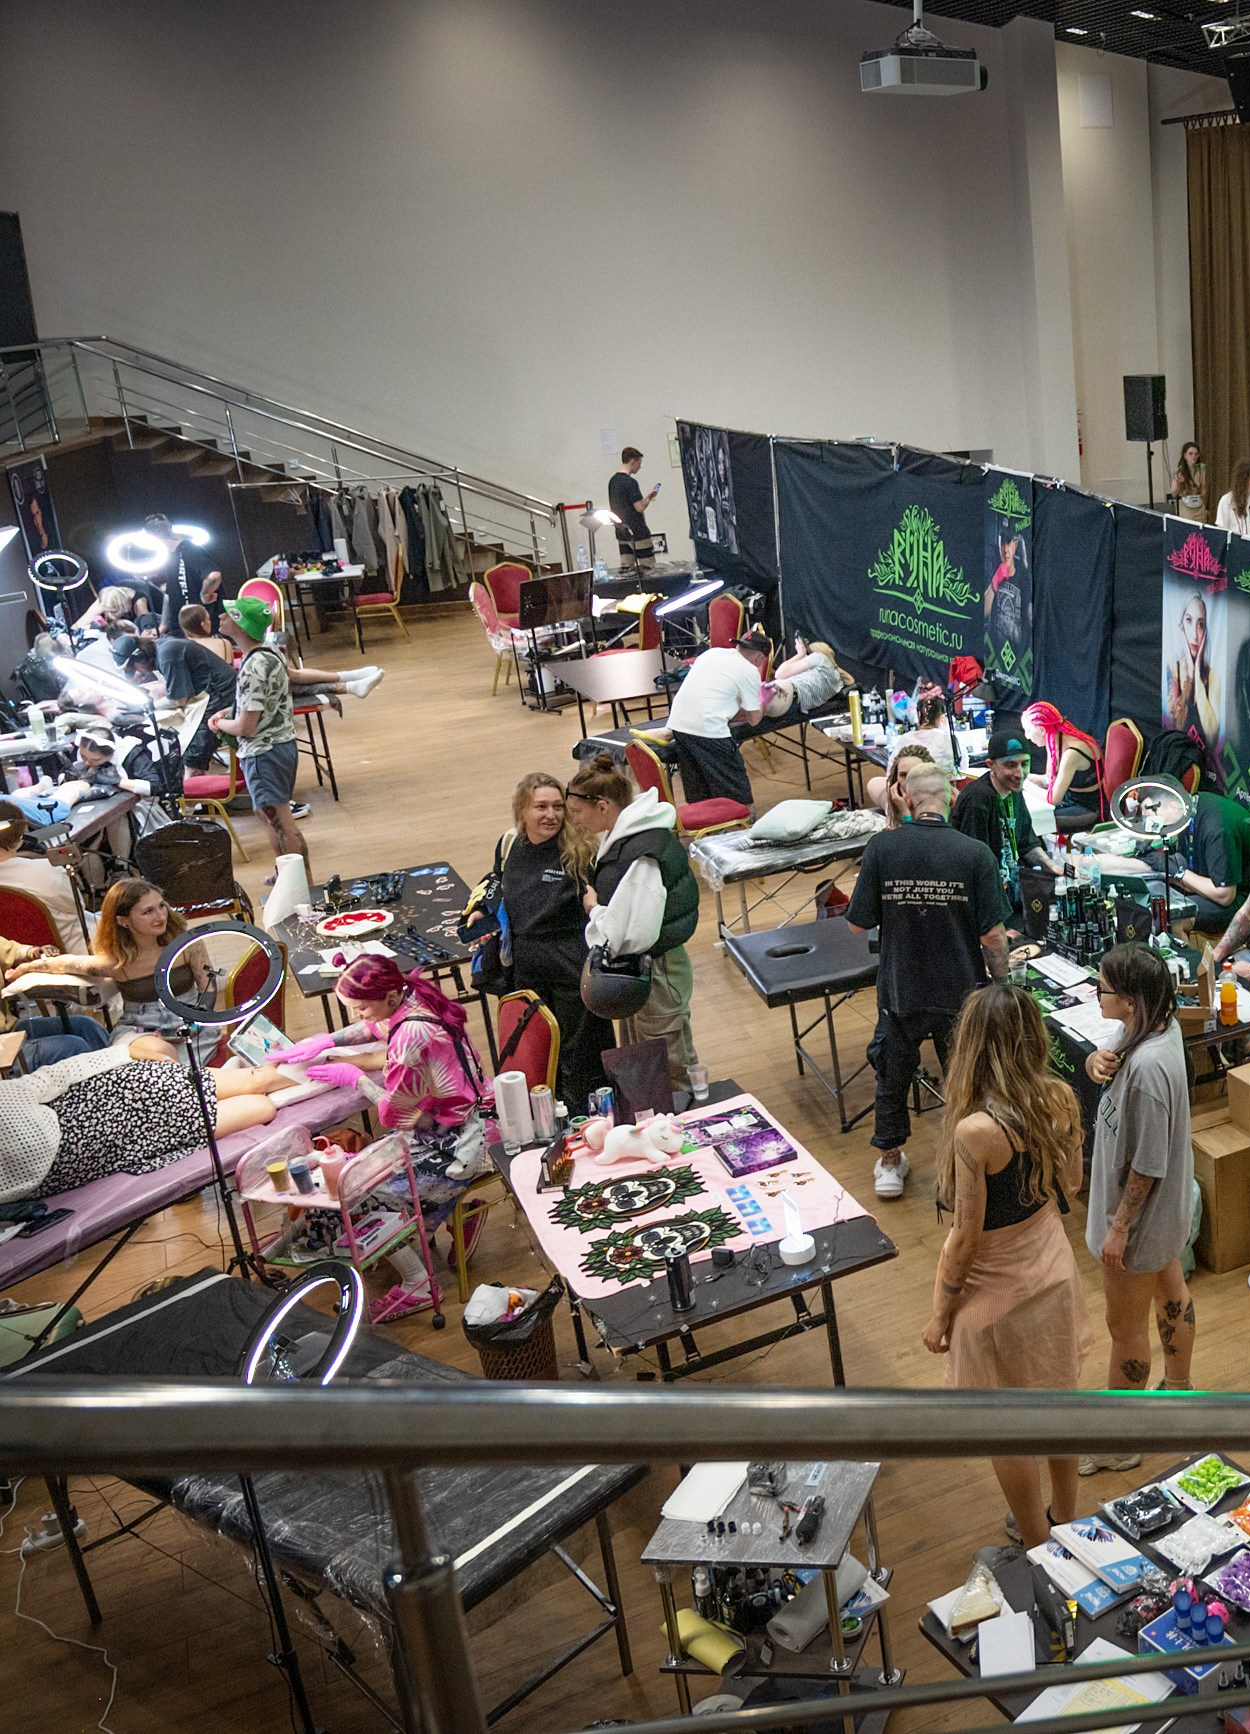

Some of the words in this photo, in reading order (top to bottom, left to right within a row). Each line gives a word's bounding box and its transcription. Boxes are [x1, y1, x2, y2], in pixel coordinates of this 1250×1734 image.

[879, 607, 963, 650] runacosmetic.ru
[916, 880, 947, 888] WORLD
[923, 894, 969, 902] TOGETHER
